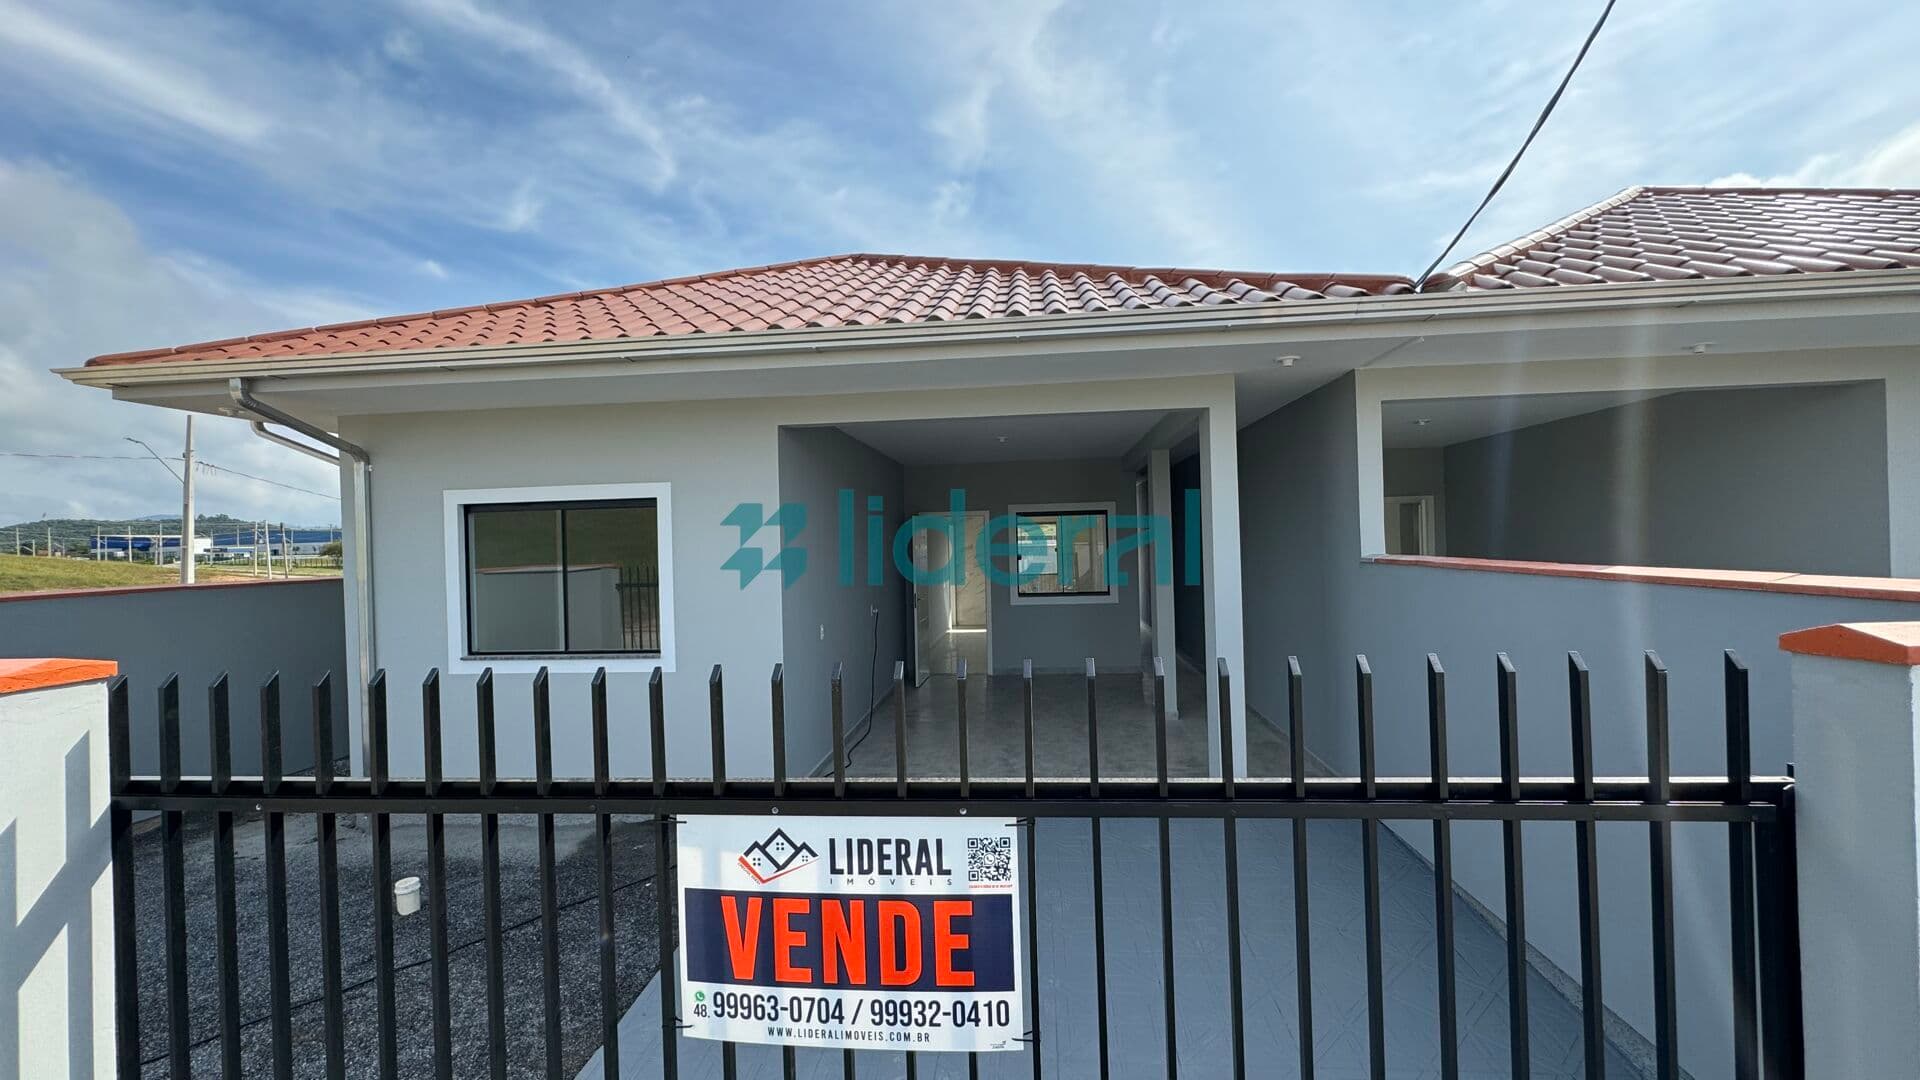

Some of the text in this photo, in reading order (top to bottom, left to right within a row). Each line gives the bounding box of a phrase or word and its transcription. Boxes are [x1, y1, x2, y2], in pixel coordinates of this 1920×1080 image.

[828, 838, 952, 876] LIDERAL
[721, 895, 976, 987] VENDE
[693, 991, 1010, 1028] 48. 99963-0704 / 99932-0410
[767, 1026, 931, 1043] WWW.LIDERALIMOVEIS.COM.BR
